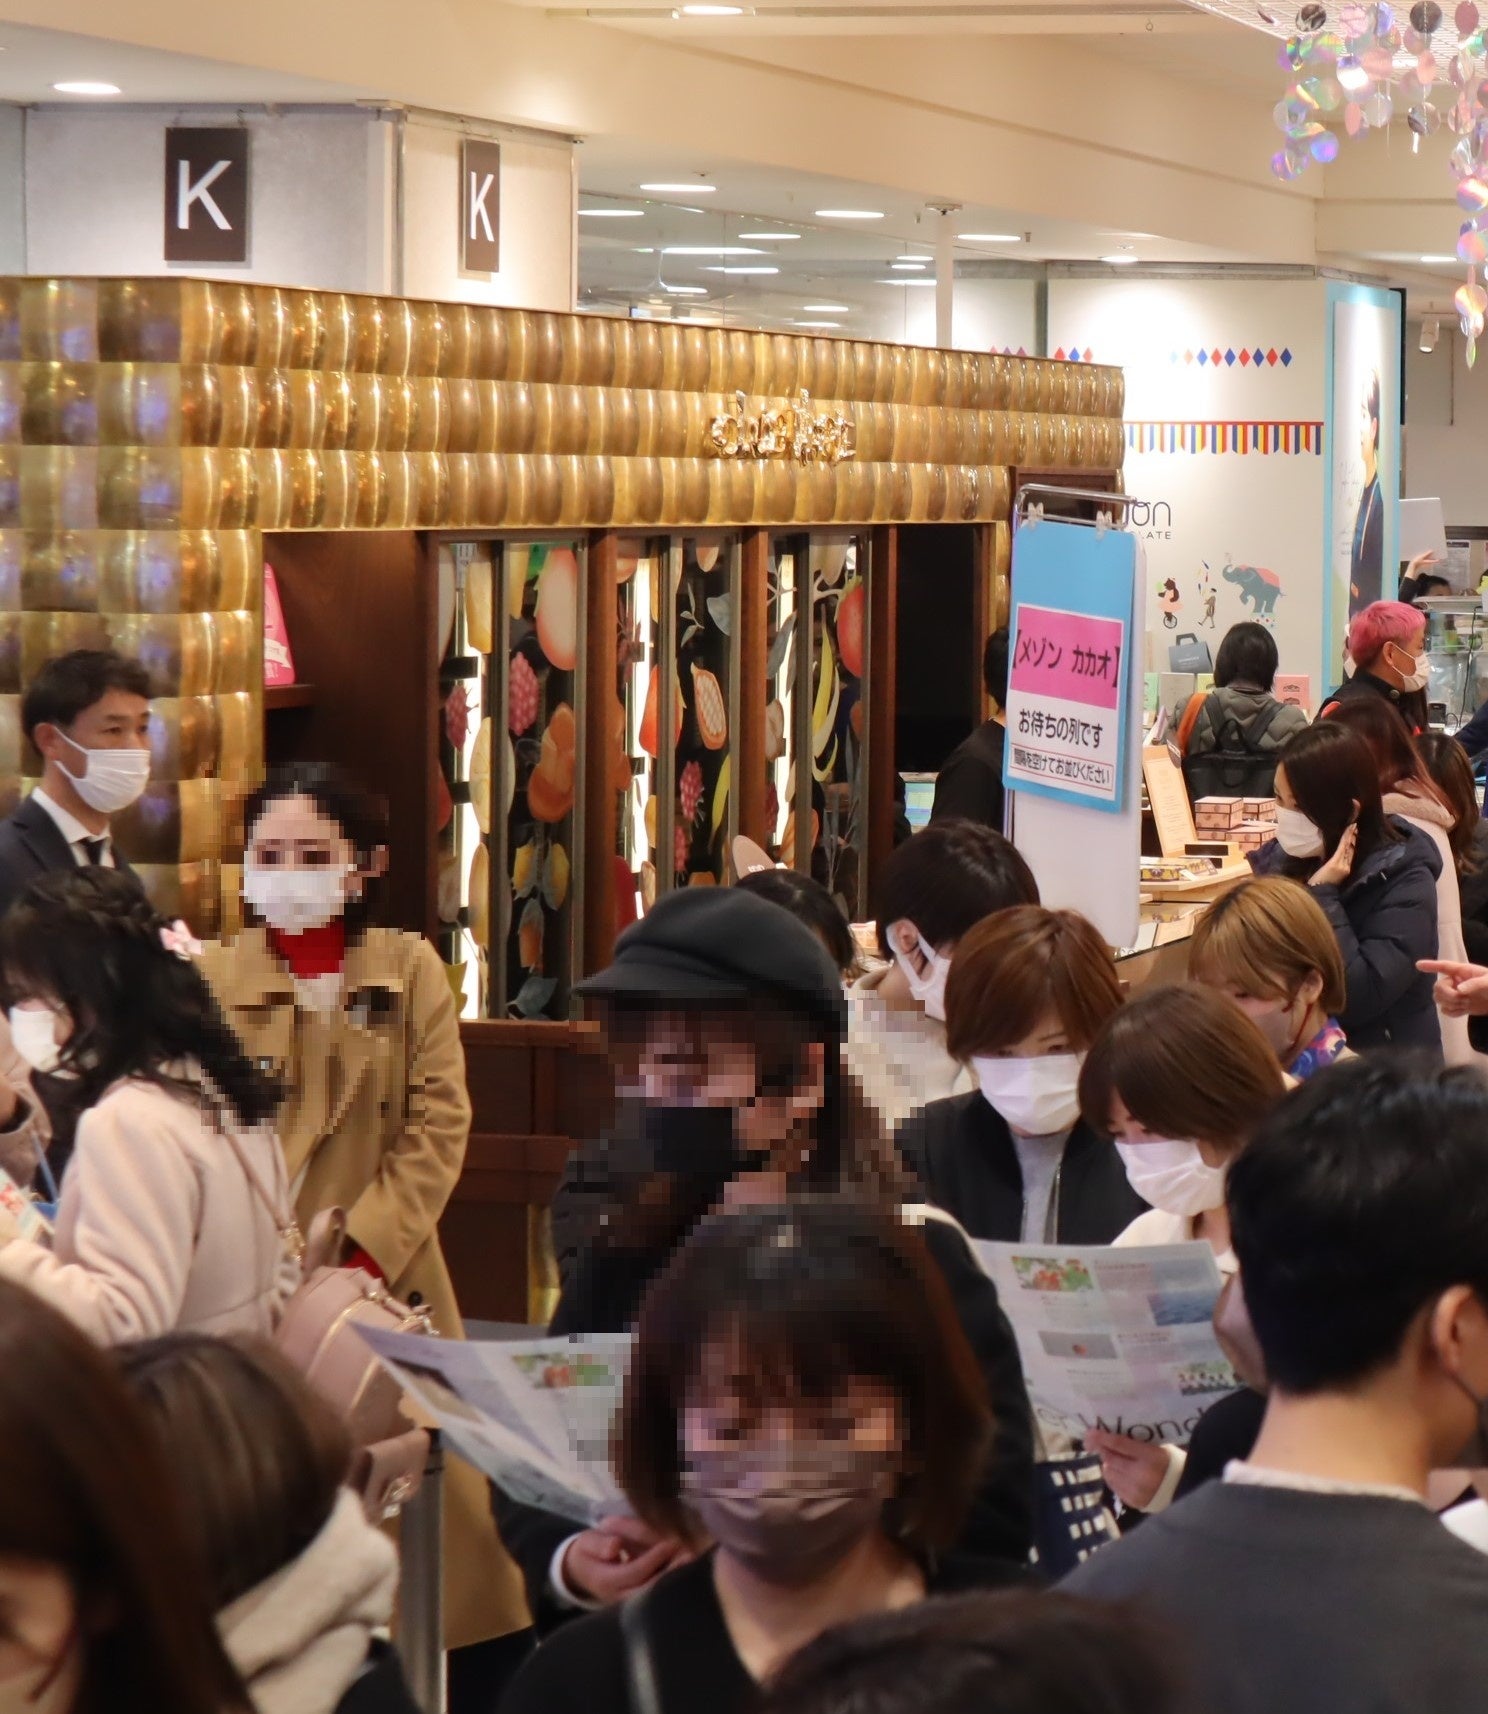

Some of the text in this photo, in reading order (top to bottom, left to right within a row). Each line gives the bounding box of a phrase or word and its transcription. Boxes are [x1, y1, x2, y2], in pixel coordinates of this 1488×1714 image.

[177, 159, 232, 230] K
[470, 171, 495, 242] K
[1018, 708, 1104, 749] お待ちの列です
